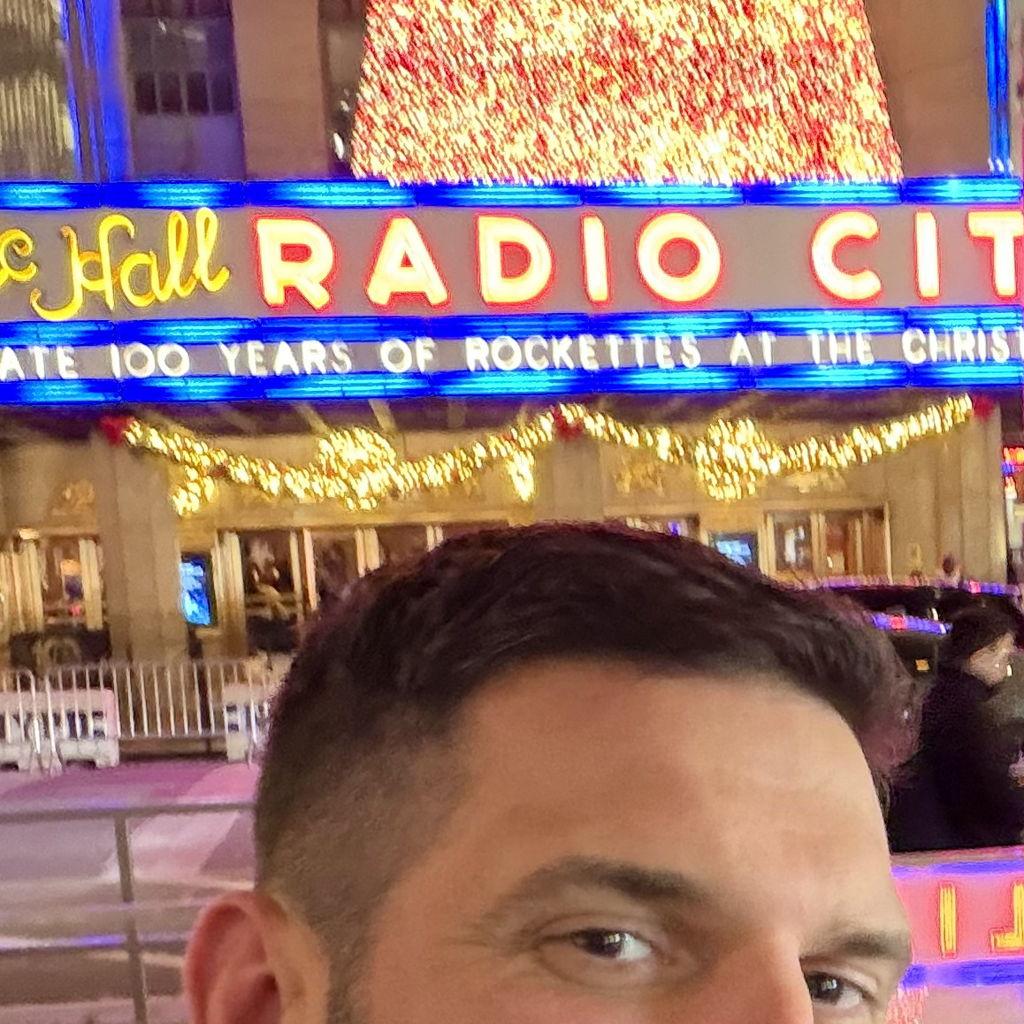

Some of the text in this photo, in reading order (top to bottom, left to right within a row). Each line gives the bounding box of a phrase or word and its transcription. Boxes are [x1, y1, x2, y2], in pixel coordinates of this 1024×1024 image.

[30, 206, 230, 321] Hall
[256, 212, 722, 310] RADIO
[109, 342, 190, 378] 100
[218, 339, 352, 377] YEARS
[380, 337, 436, 373] OF
[464, 332, 701, 372] ROCKETTES
[729, 330, 776, 367] AT
[806, 328, 875, 367] THE
